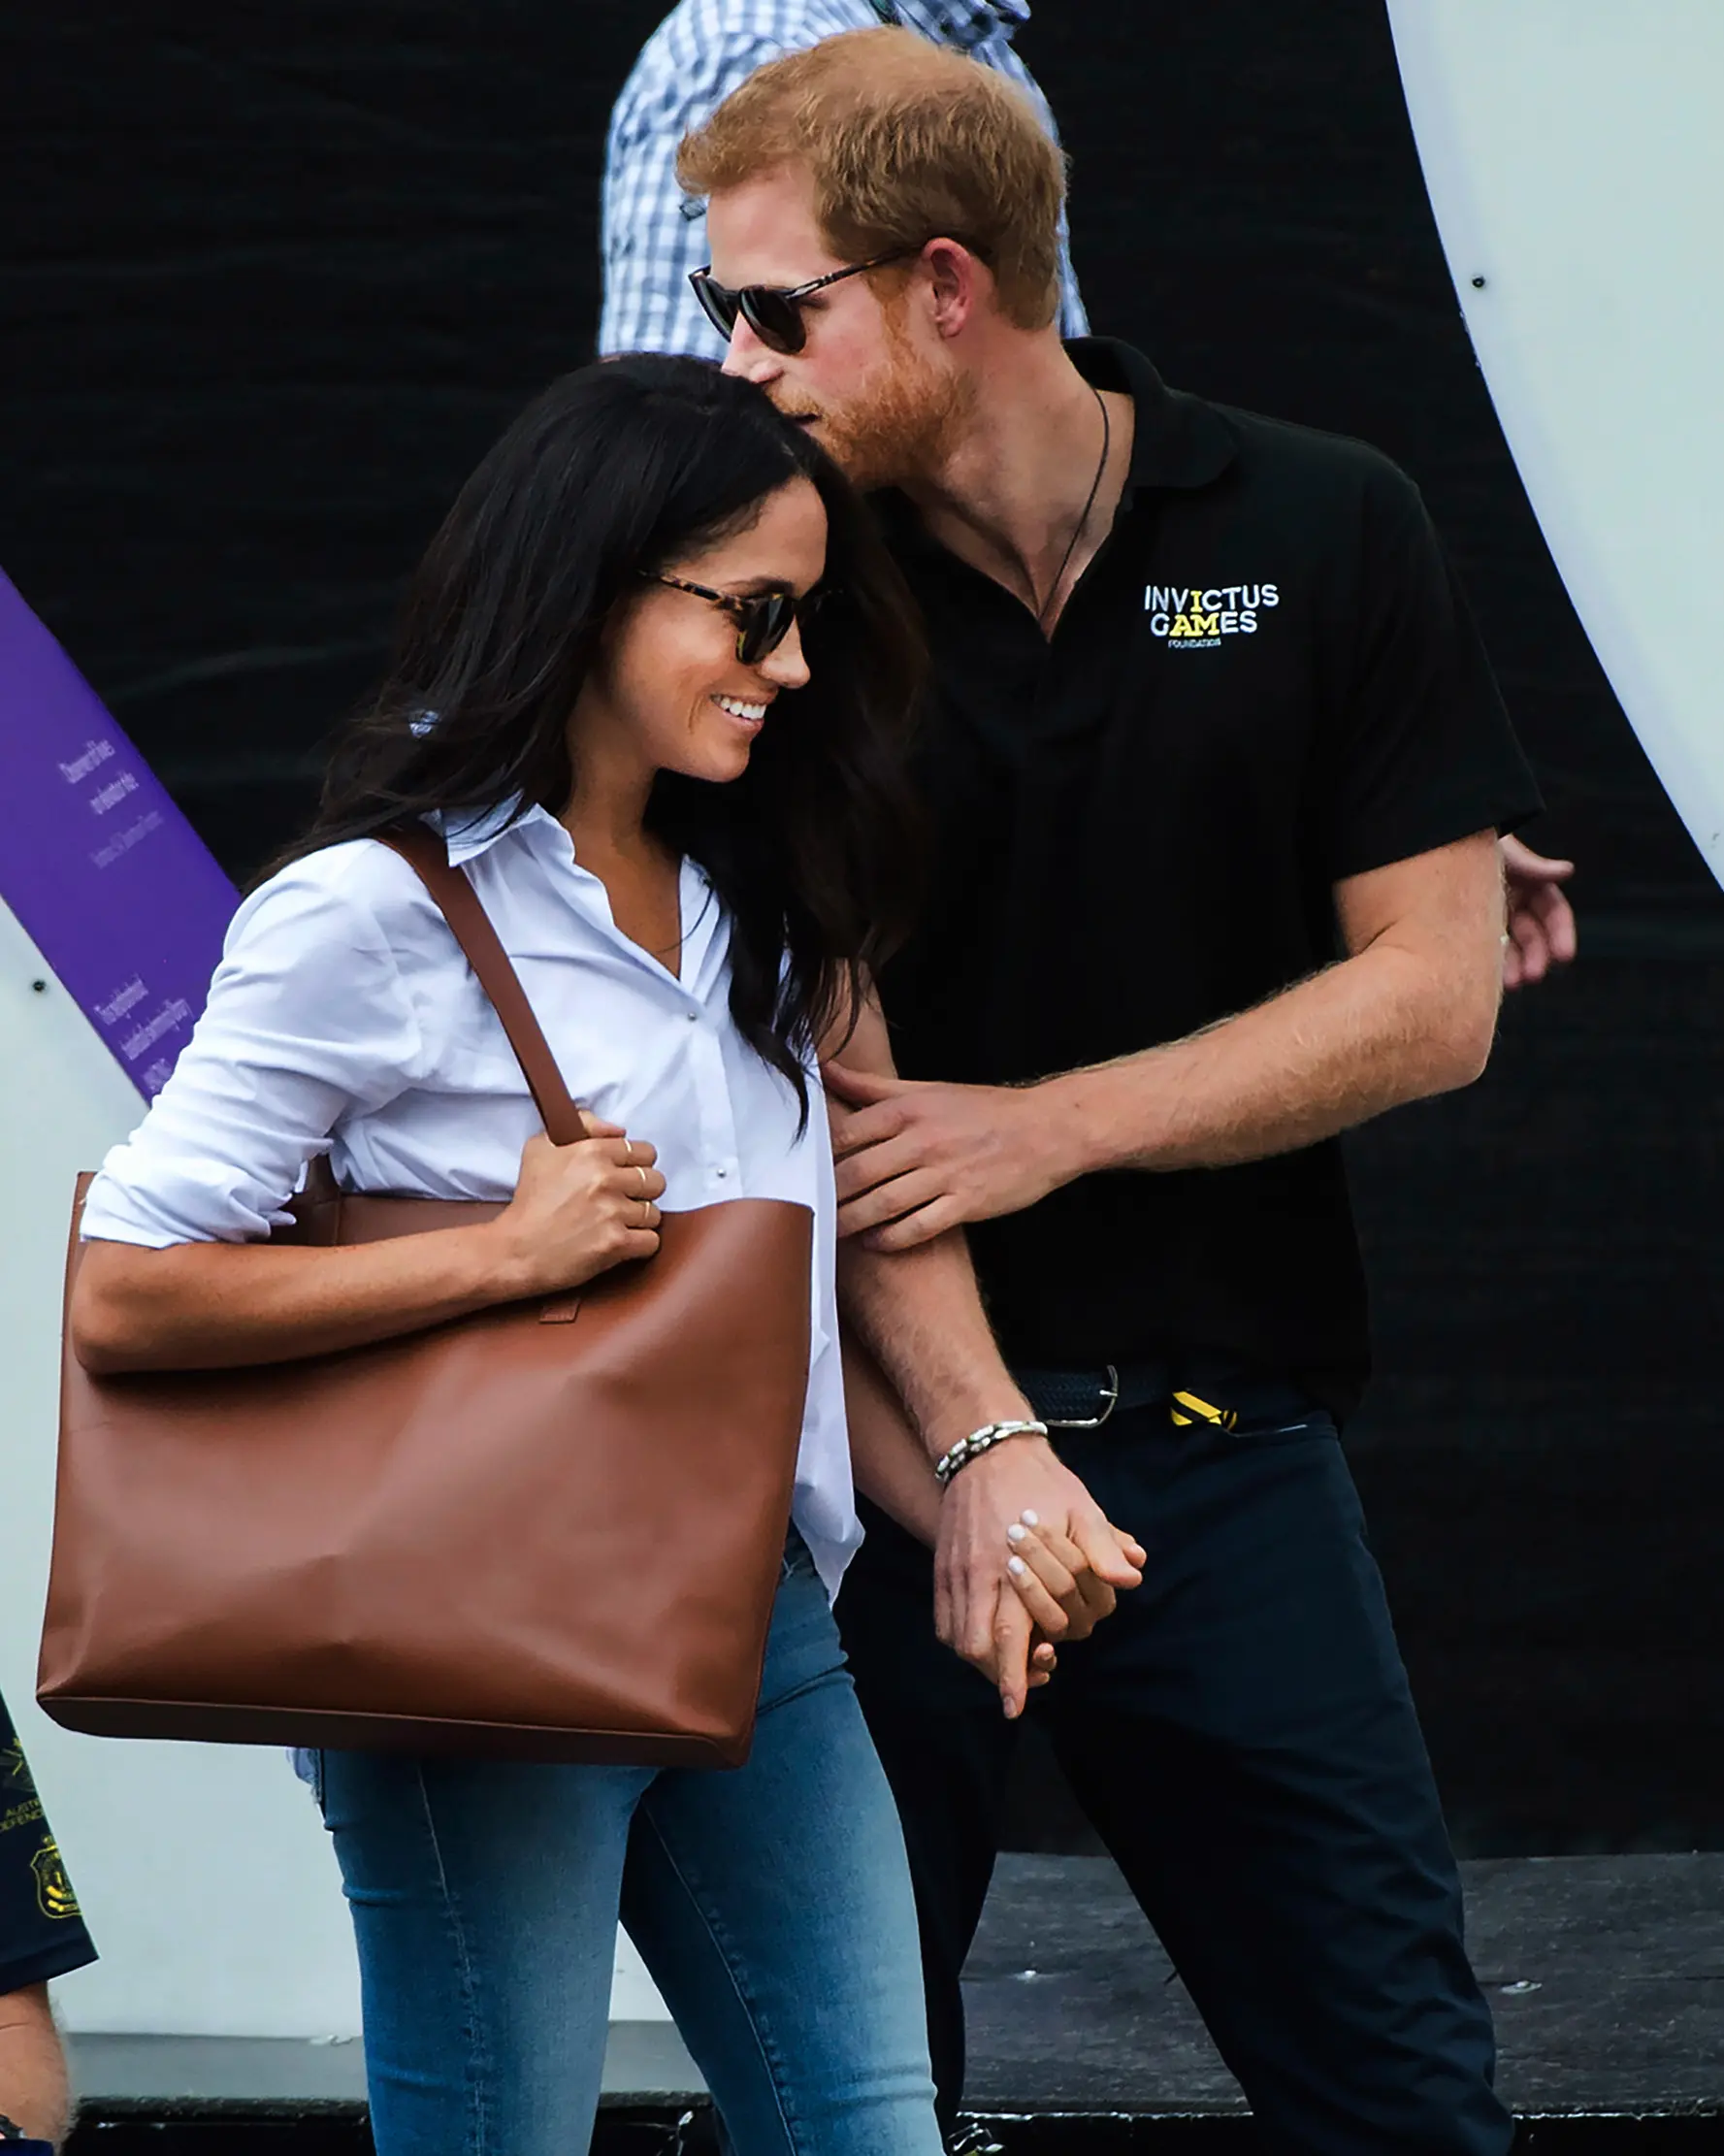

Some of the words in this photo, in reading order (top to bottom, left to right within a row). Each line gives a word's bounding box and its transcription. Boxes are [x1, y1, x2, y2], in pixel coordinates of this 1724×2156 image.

[1144, 584, 1280, 613] INVICTUS
[1151, 610, 1258, 637] GAMES
[1168, 637, 1221, 649] FOUNDATION
